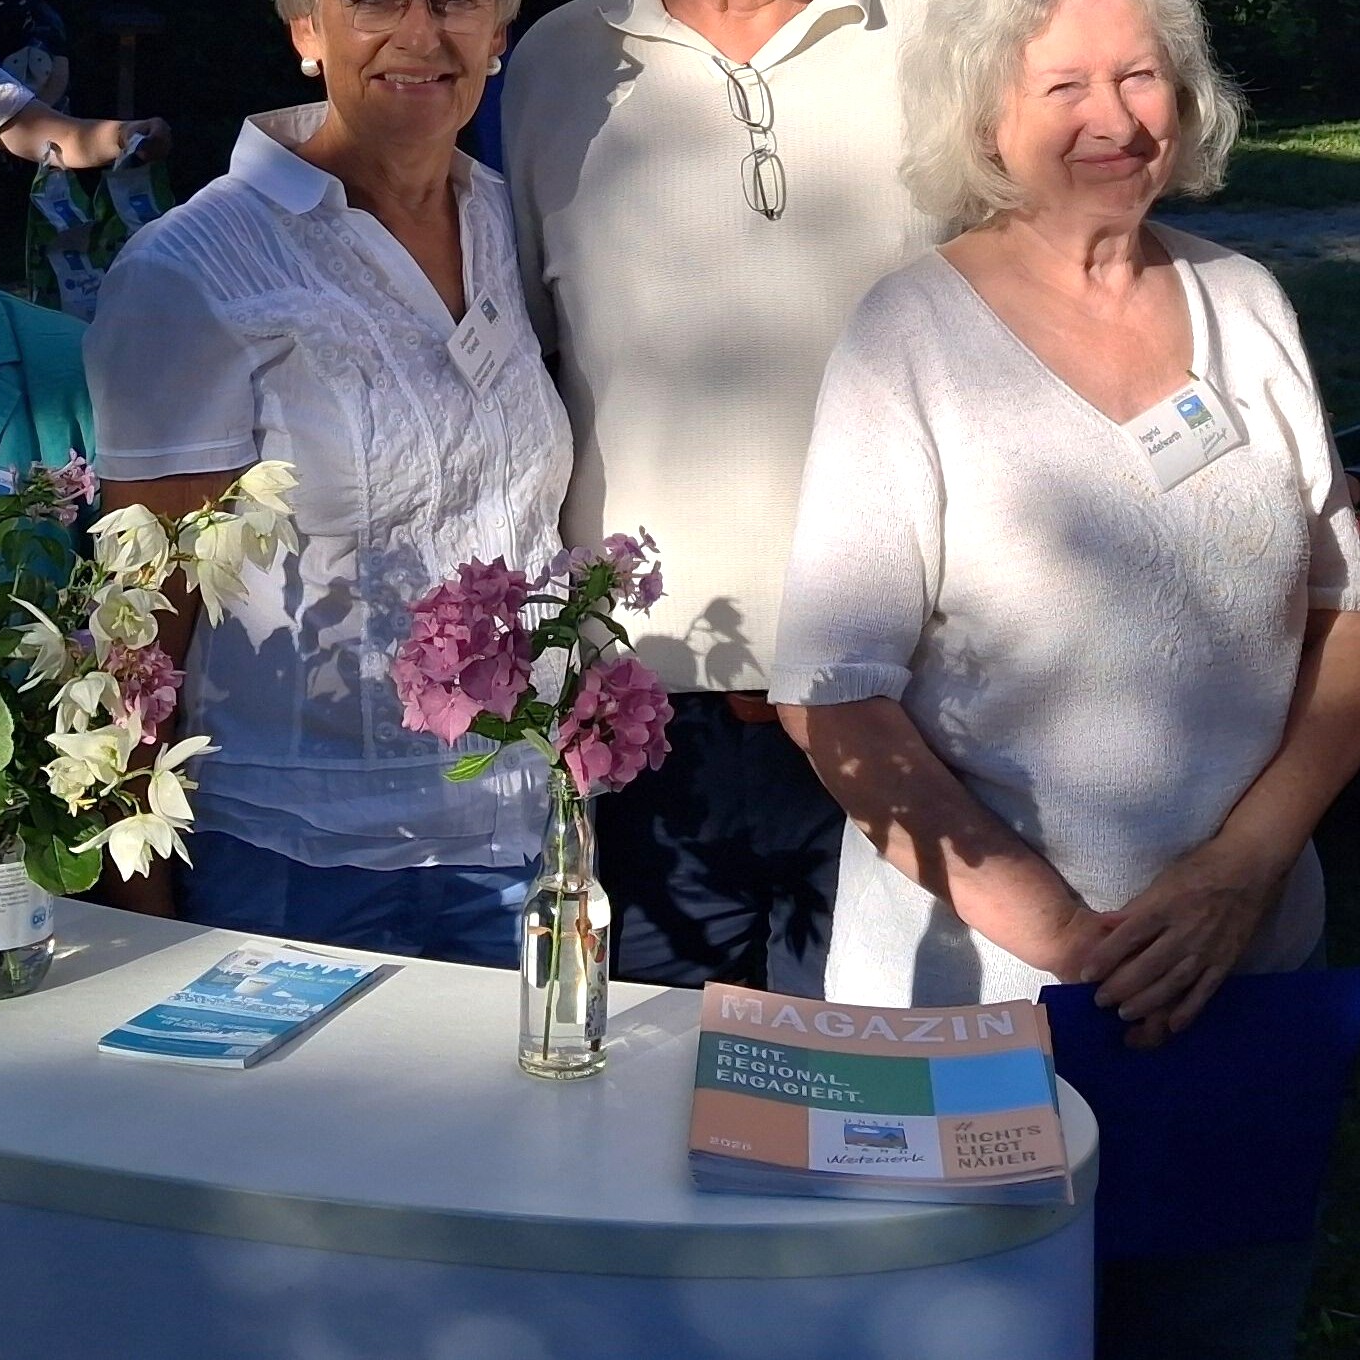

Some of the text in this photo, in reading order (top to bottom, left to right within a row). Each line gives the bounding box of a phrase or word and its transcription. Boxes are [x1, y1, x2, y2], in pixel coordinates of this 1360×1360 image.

[721, 994, 1015, 1042] MAGAZIN
[717, 1039, 788, 1063] ECHT.
[716, 1054, 851, 1087] REGIONAL.
[715, 1068, 865, 1104] ENGAGIERT.
[954, 1125, 1042, 1144] NICHTS
[956, 1140, 1022, 1157] LIEGT
